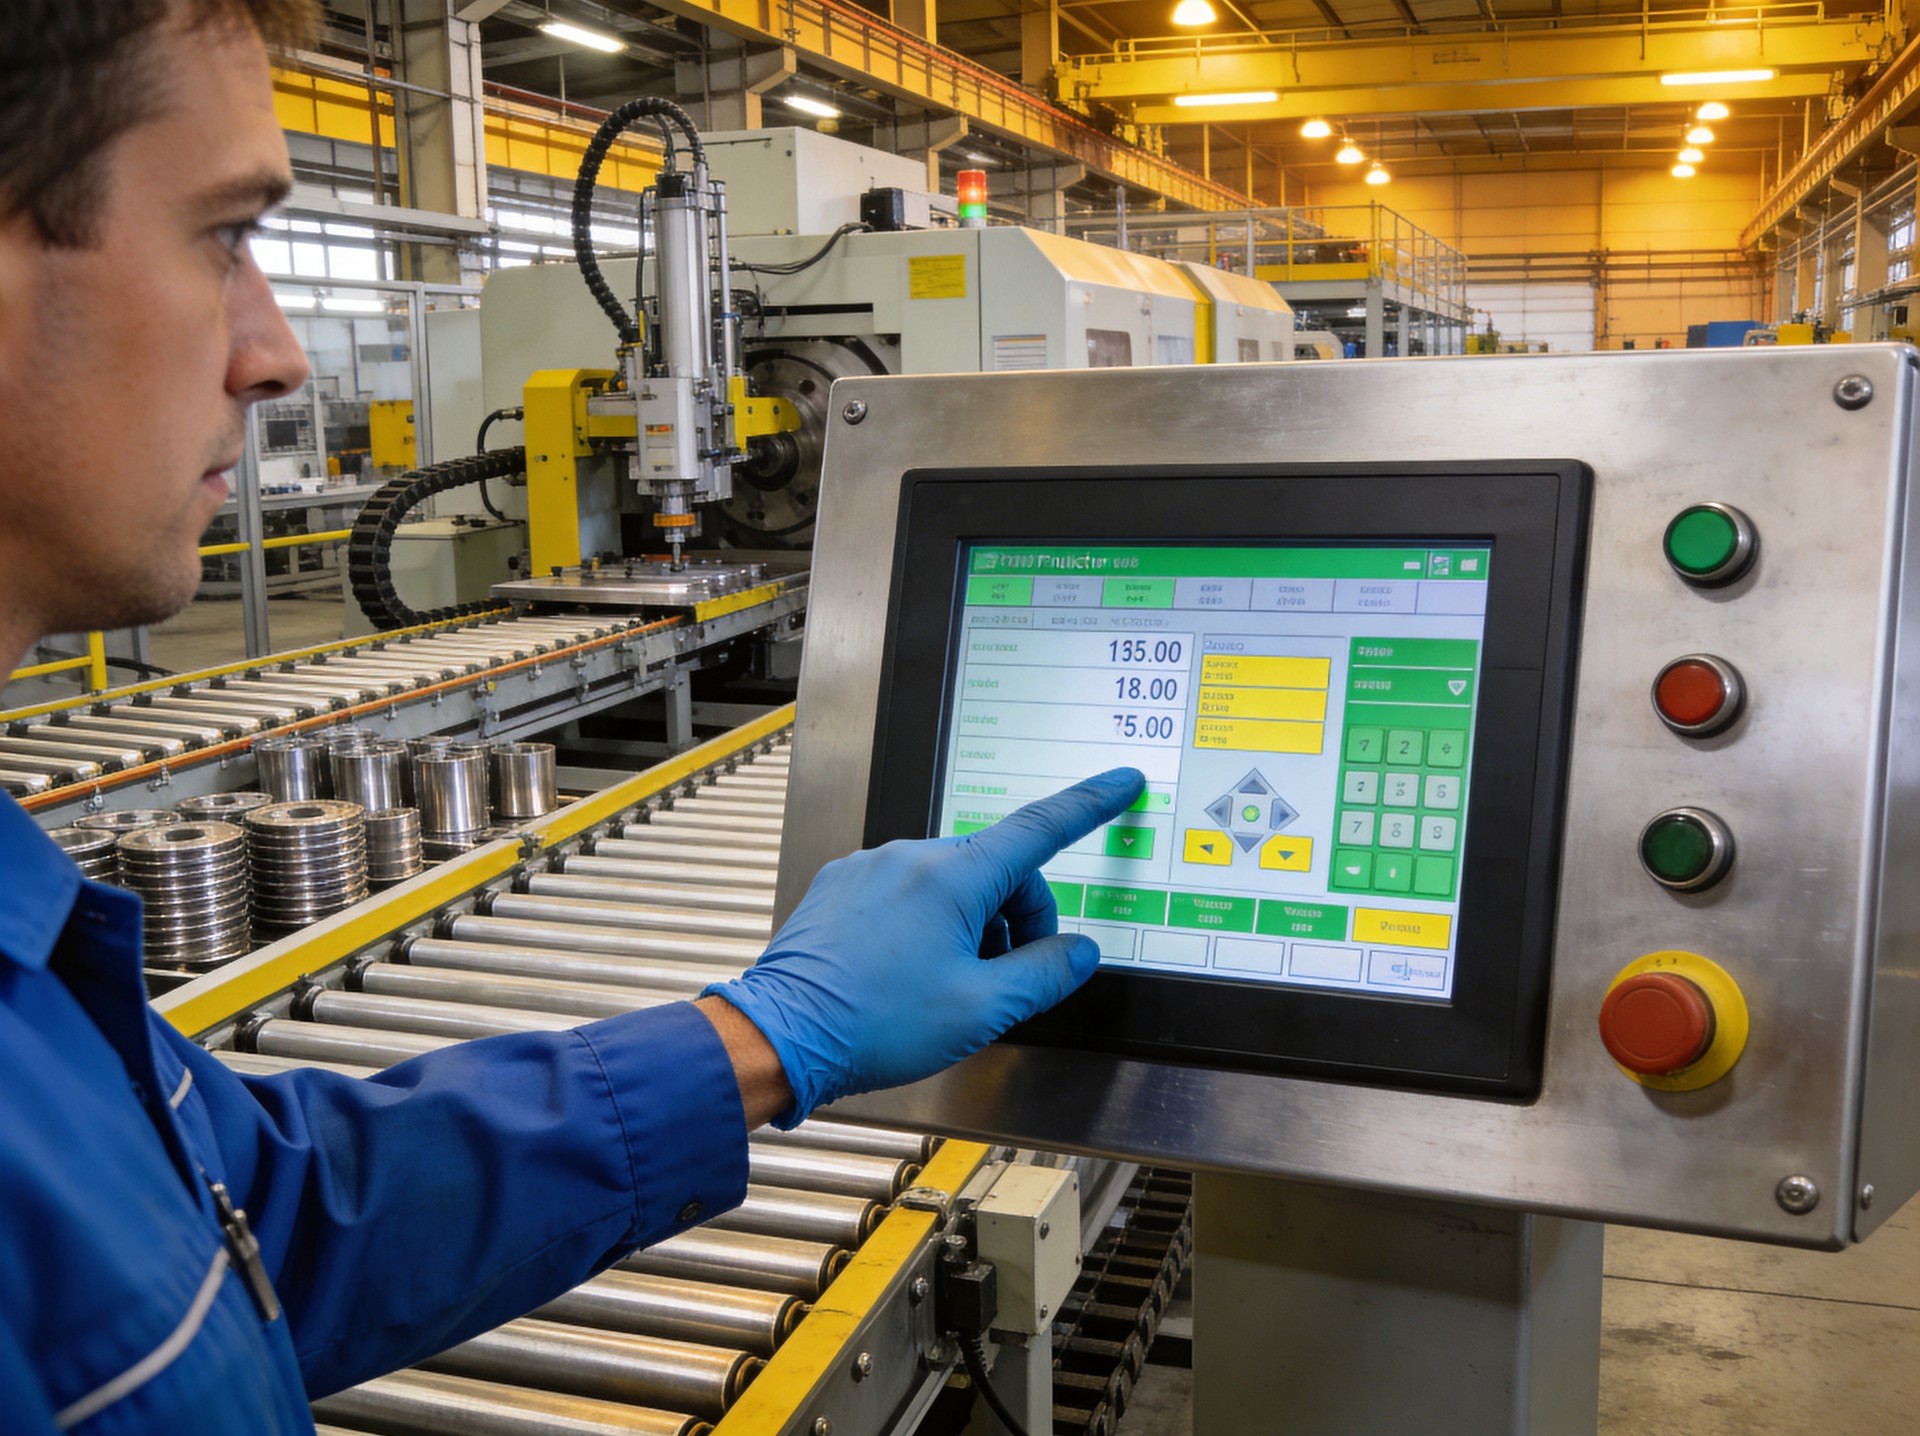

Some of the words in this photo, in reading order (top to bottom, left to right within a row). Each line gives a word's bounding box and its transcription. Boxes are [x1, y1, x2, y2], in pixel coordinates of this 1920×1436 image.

[1109, 639, 1182, 663] 135.00
[1116, 677, 1177, 701] 18.00
[1113, 714, 1173, 739] 75.00
[1352, 820, 1362, 834] 7
